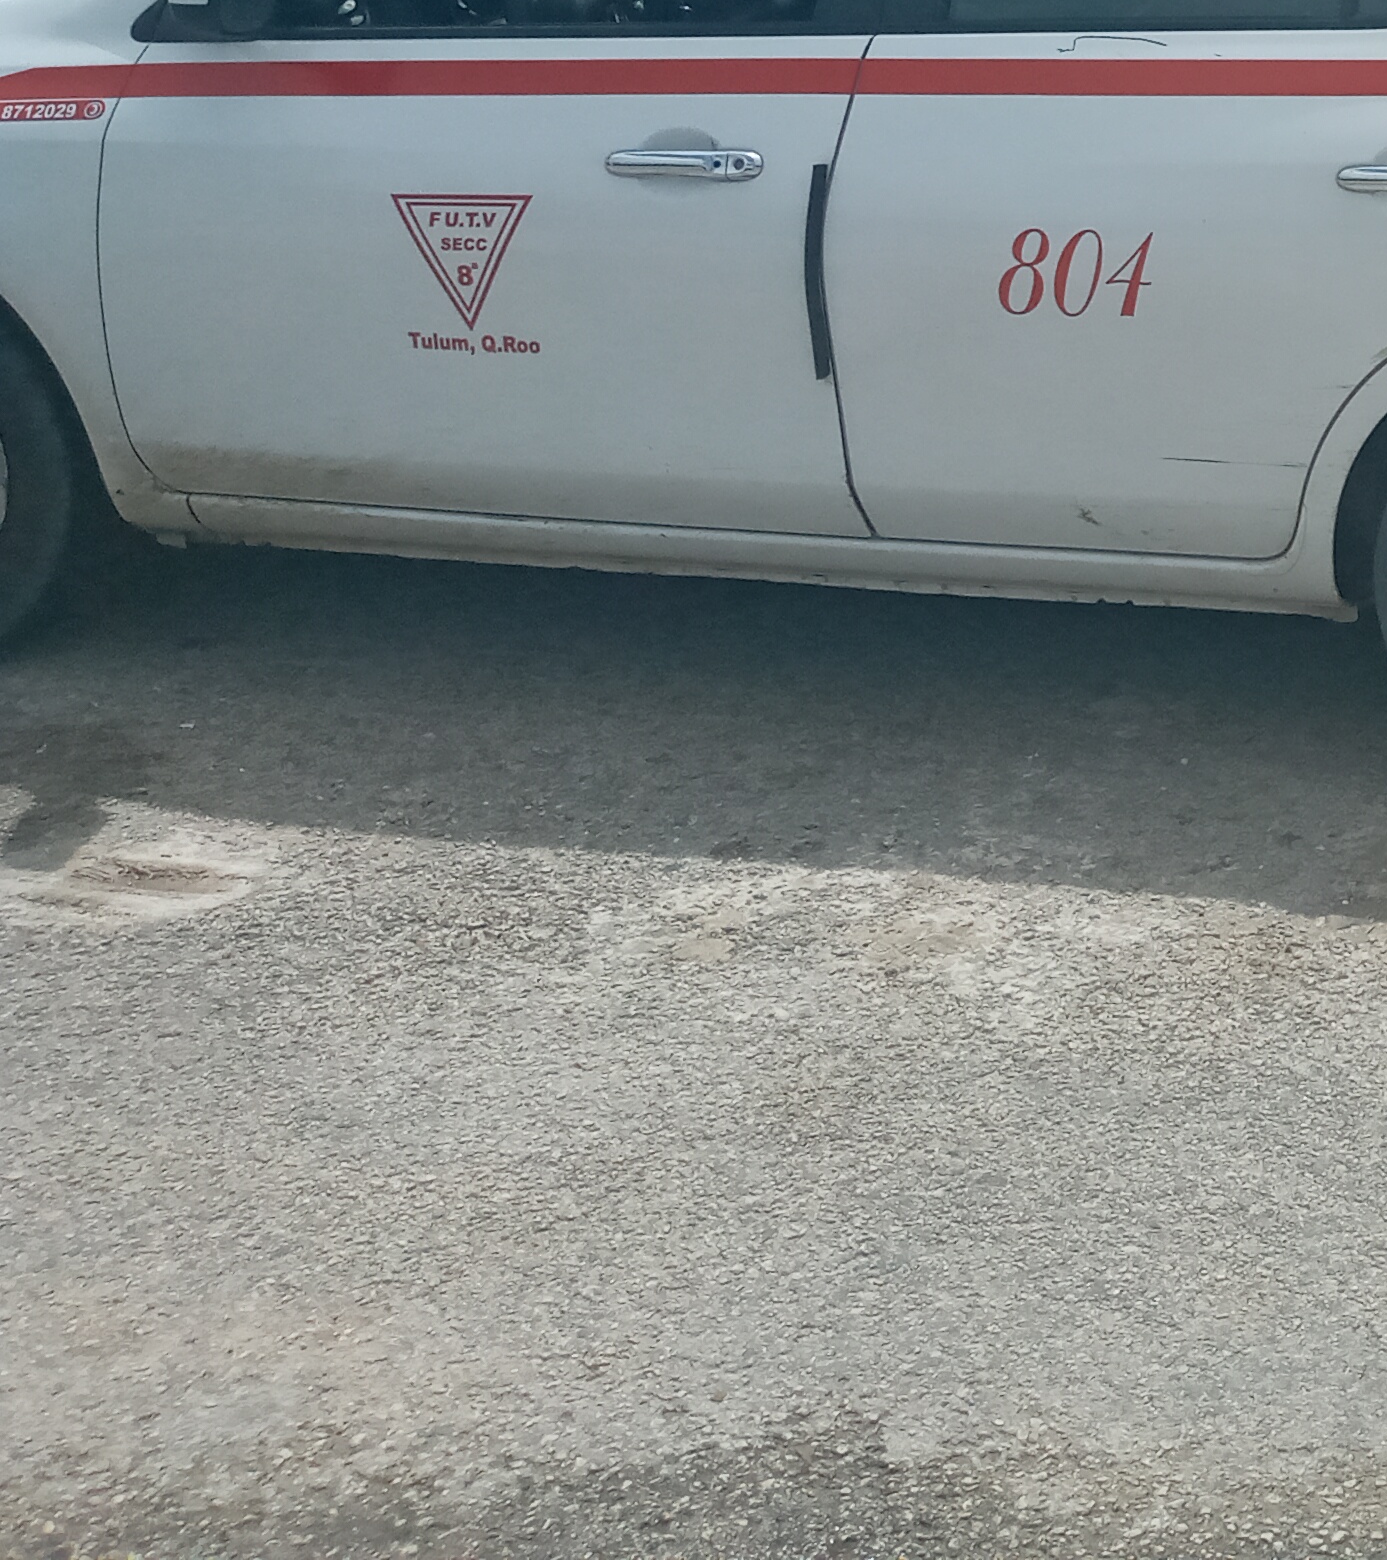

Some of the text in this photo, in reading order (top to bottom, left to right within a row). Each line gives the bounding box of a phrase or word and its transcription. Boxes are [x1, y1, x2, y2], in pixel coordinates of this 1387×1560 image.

[1, 103, 77, 119] 8712029
[440, 237, 488, 252] SECC
[998, 228, 1154, 317] 804
[408, 331, 541, 356] Tulum, Q.Roo
